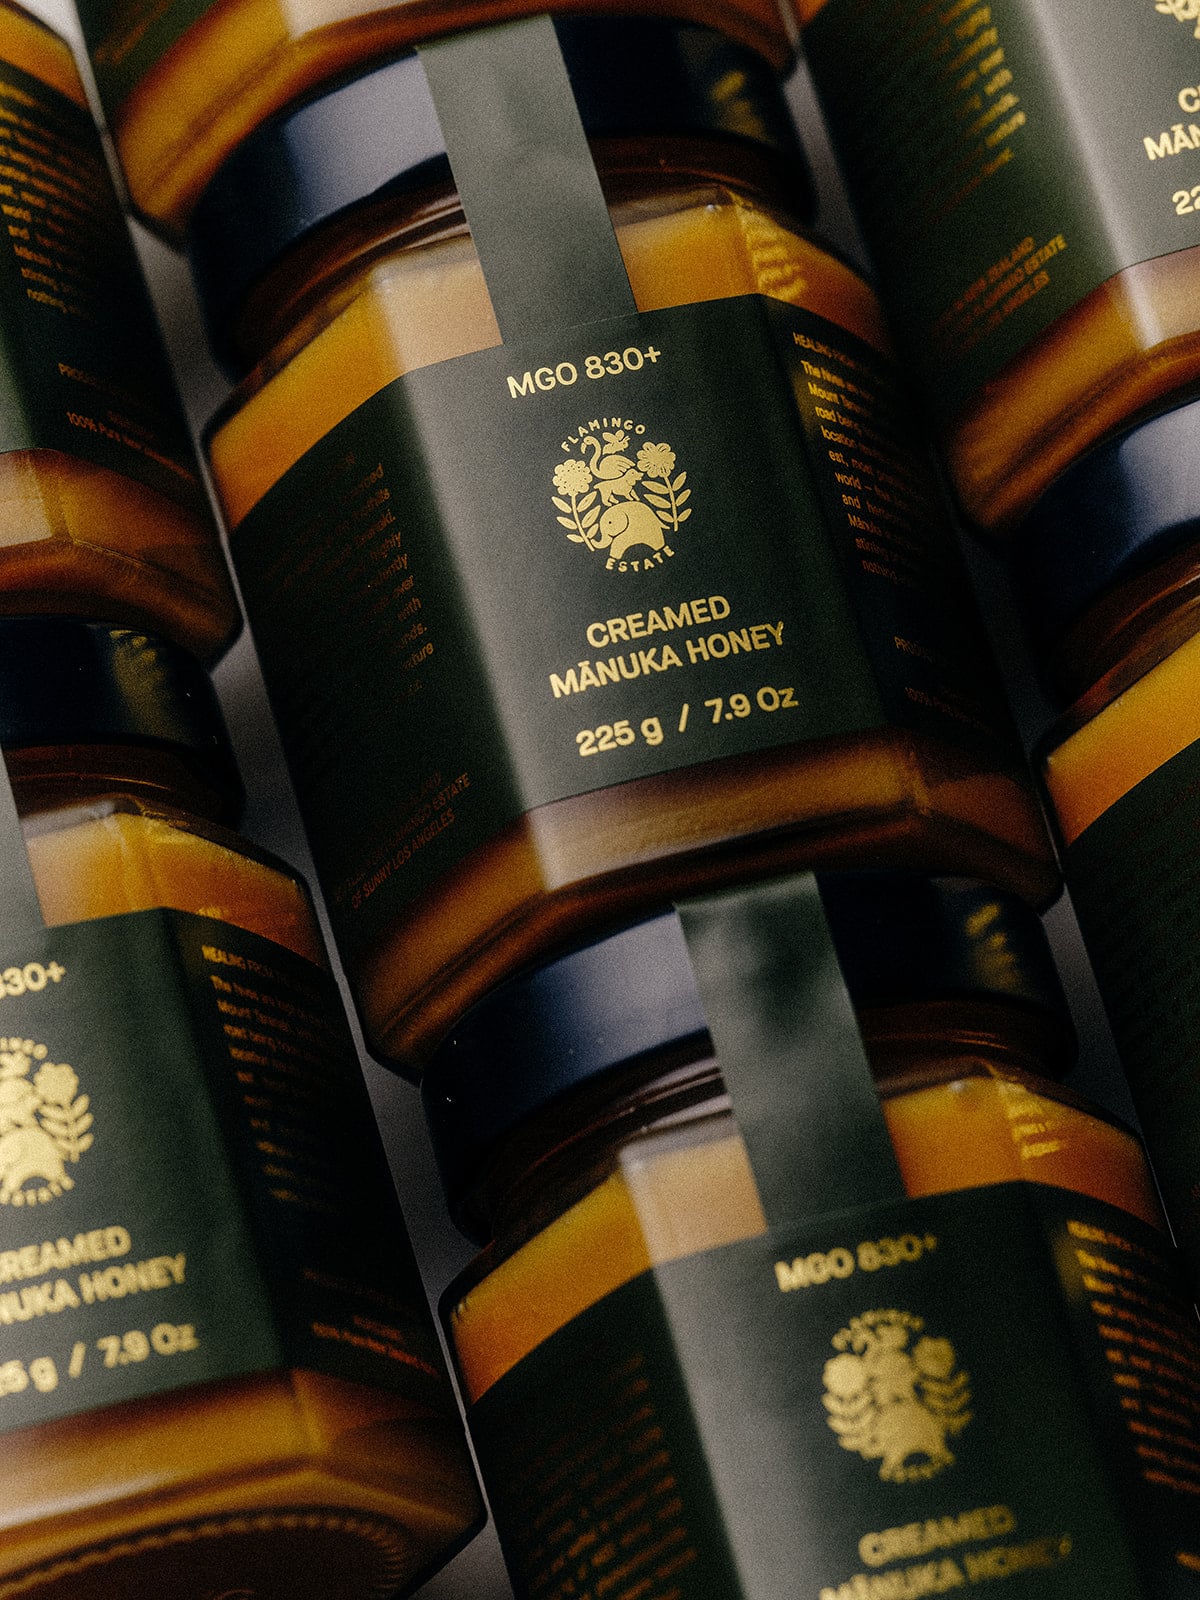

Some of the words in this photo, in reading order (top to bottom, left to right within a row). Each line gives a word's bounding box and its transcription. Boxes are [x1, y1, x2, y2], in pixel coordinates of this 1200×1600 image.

[1178, 87, 1200, 113] C
[506, 362, 578, 399] MGO
[584, 346, 661, 379] 830+
[561, 417, 646, 452] FLAMINGO
[841, 492, 861, 509] and
[605, 545, 675, 572] ESTATE
[586, 596, 731, 648] CREAMED
[549, 645, 683, 698] MĀNUKA
[686, 621, 784, 665] HONEY
[576, 720, 637, 757] 225
[640, 717, 664, 746] g
[678, 703, 690, 732] /
[704, 693, 751, 724] 7.9
[756, 686, 799, 712] Oz
[0, 961, 66, 999] 30+
[78, 1252, 187, 1305] HONEY
[68, 1340, 87, 1379] /
[96, 1330, 151, 1369] 7.9
